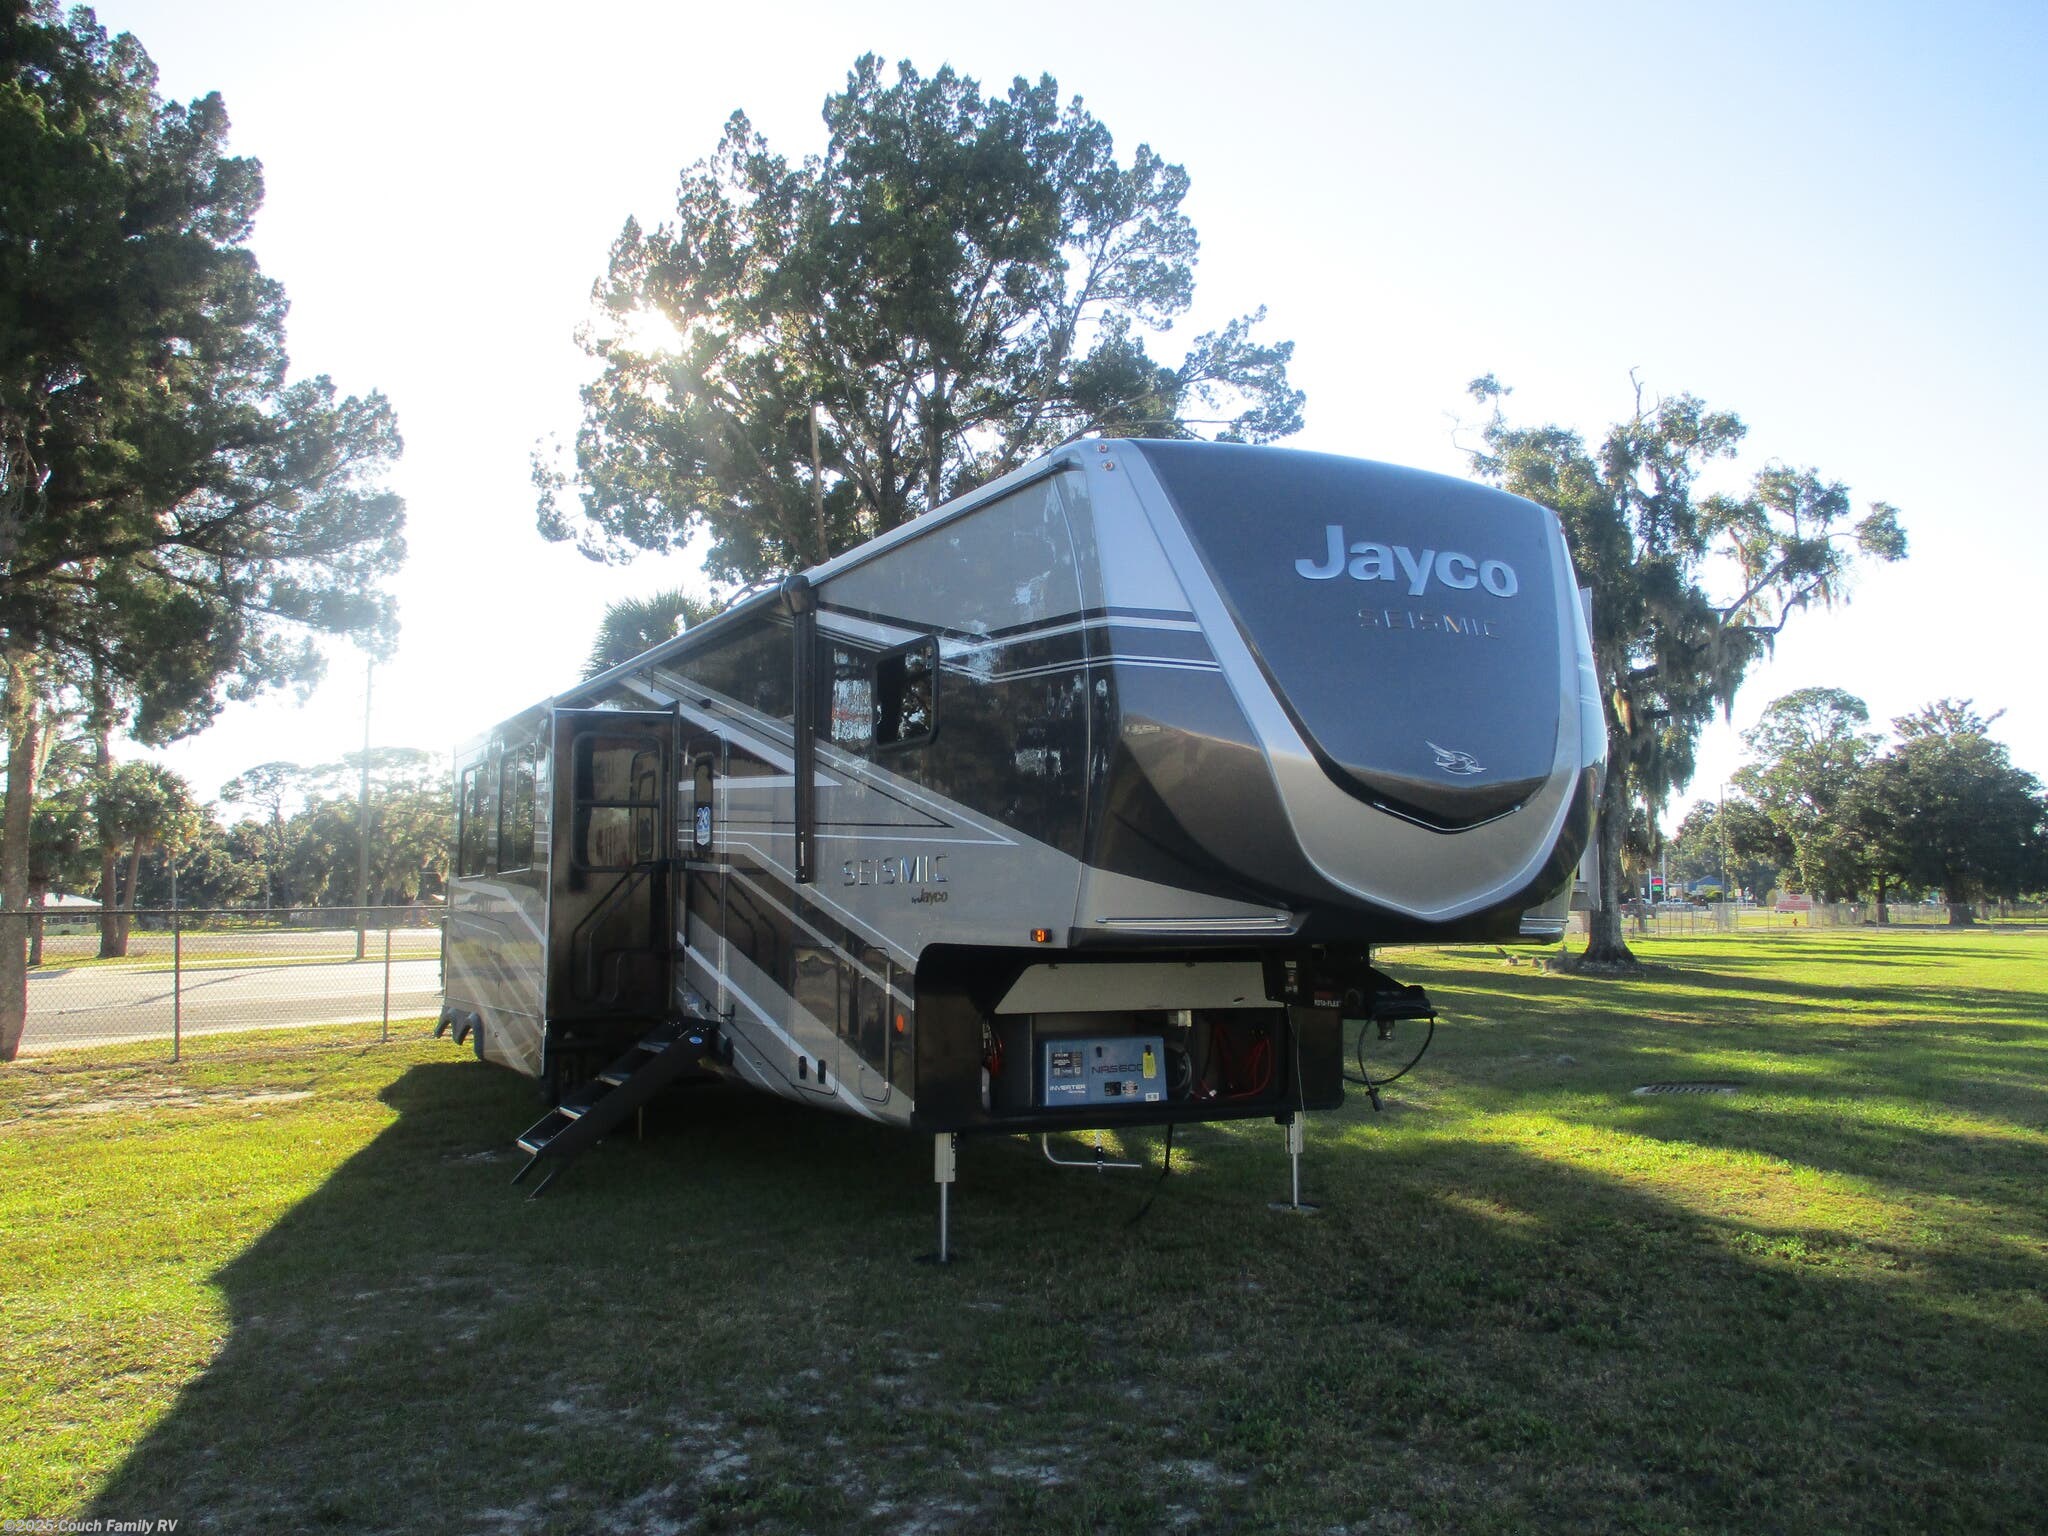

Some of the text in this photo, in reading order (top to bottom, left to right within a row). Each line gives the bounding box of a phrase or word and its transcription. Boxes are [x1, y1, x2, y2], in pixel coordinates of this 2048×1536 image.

[1294, 524, 1519, 598] Jayco
[1356, 608, 1502, 640] SEISMIC
[843, 856, 950, 886] SEISMIC
